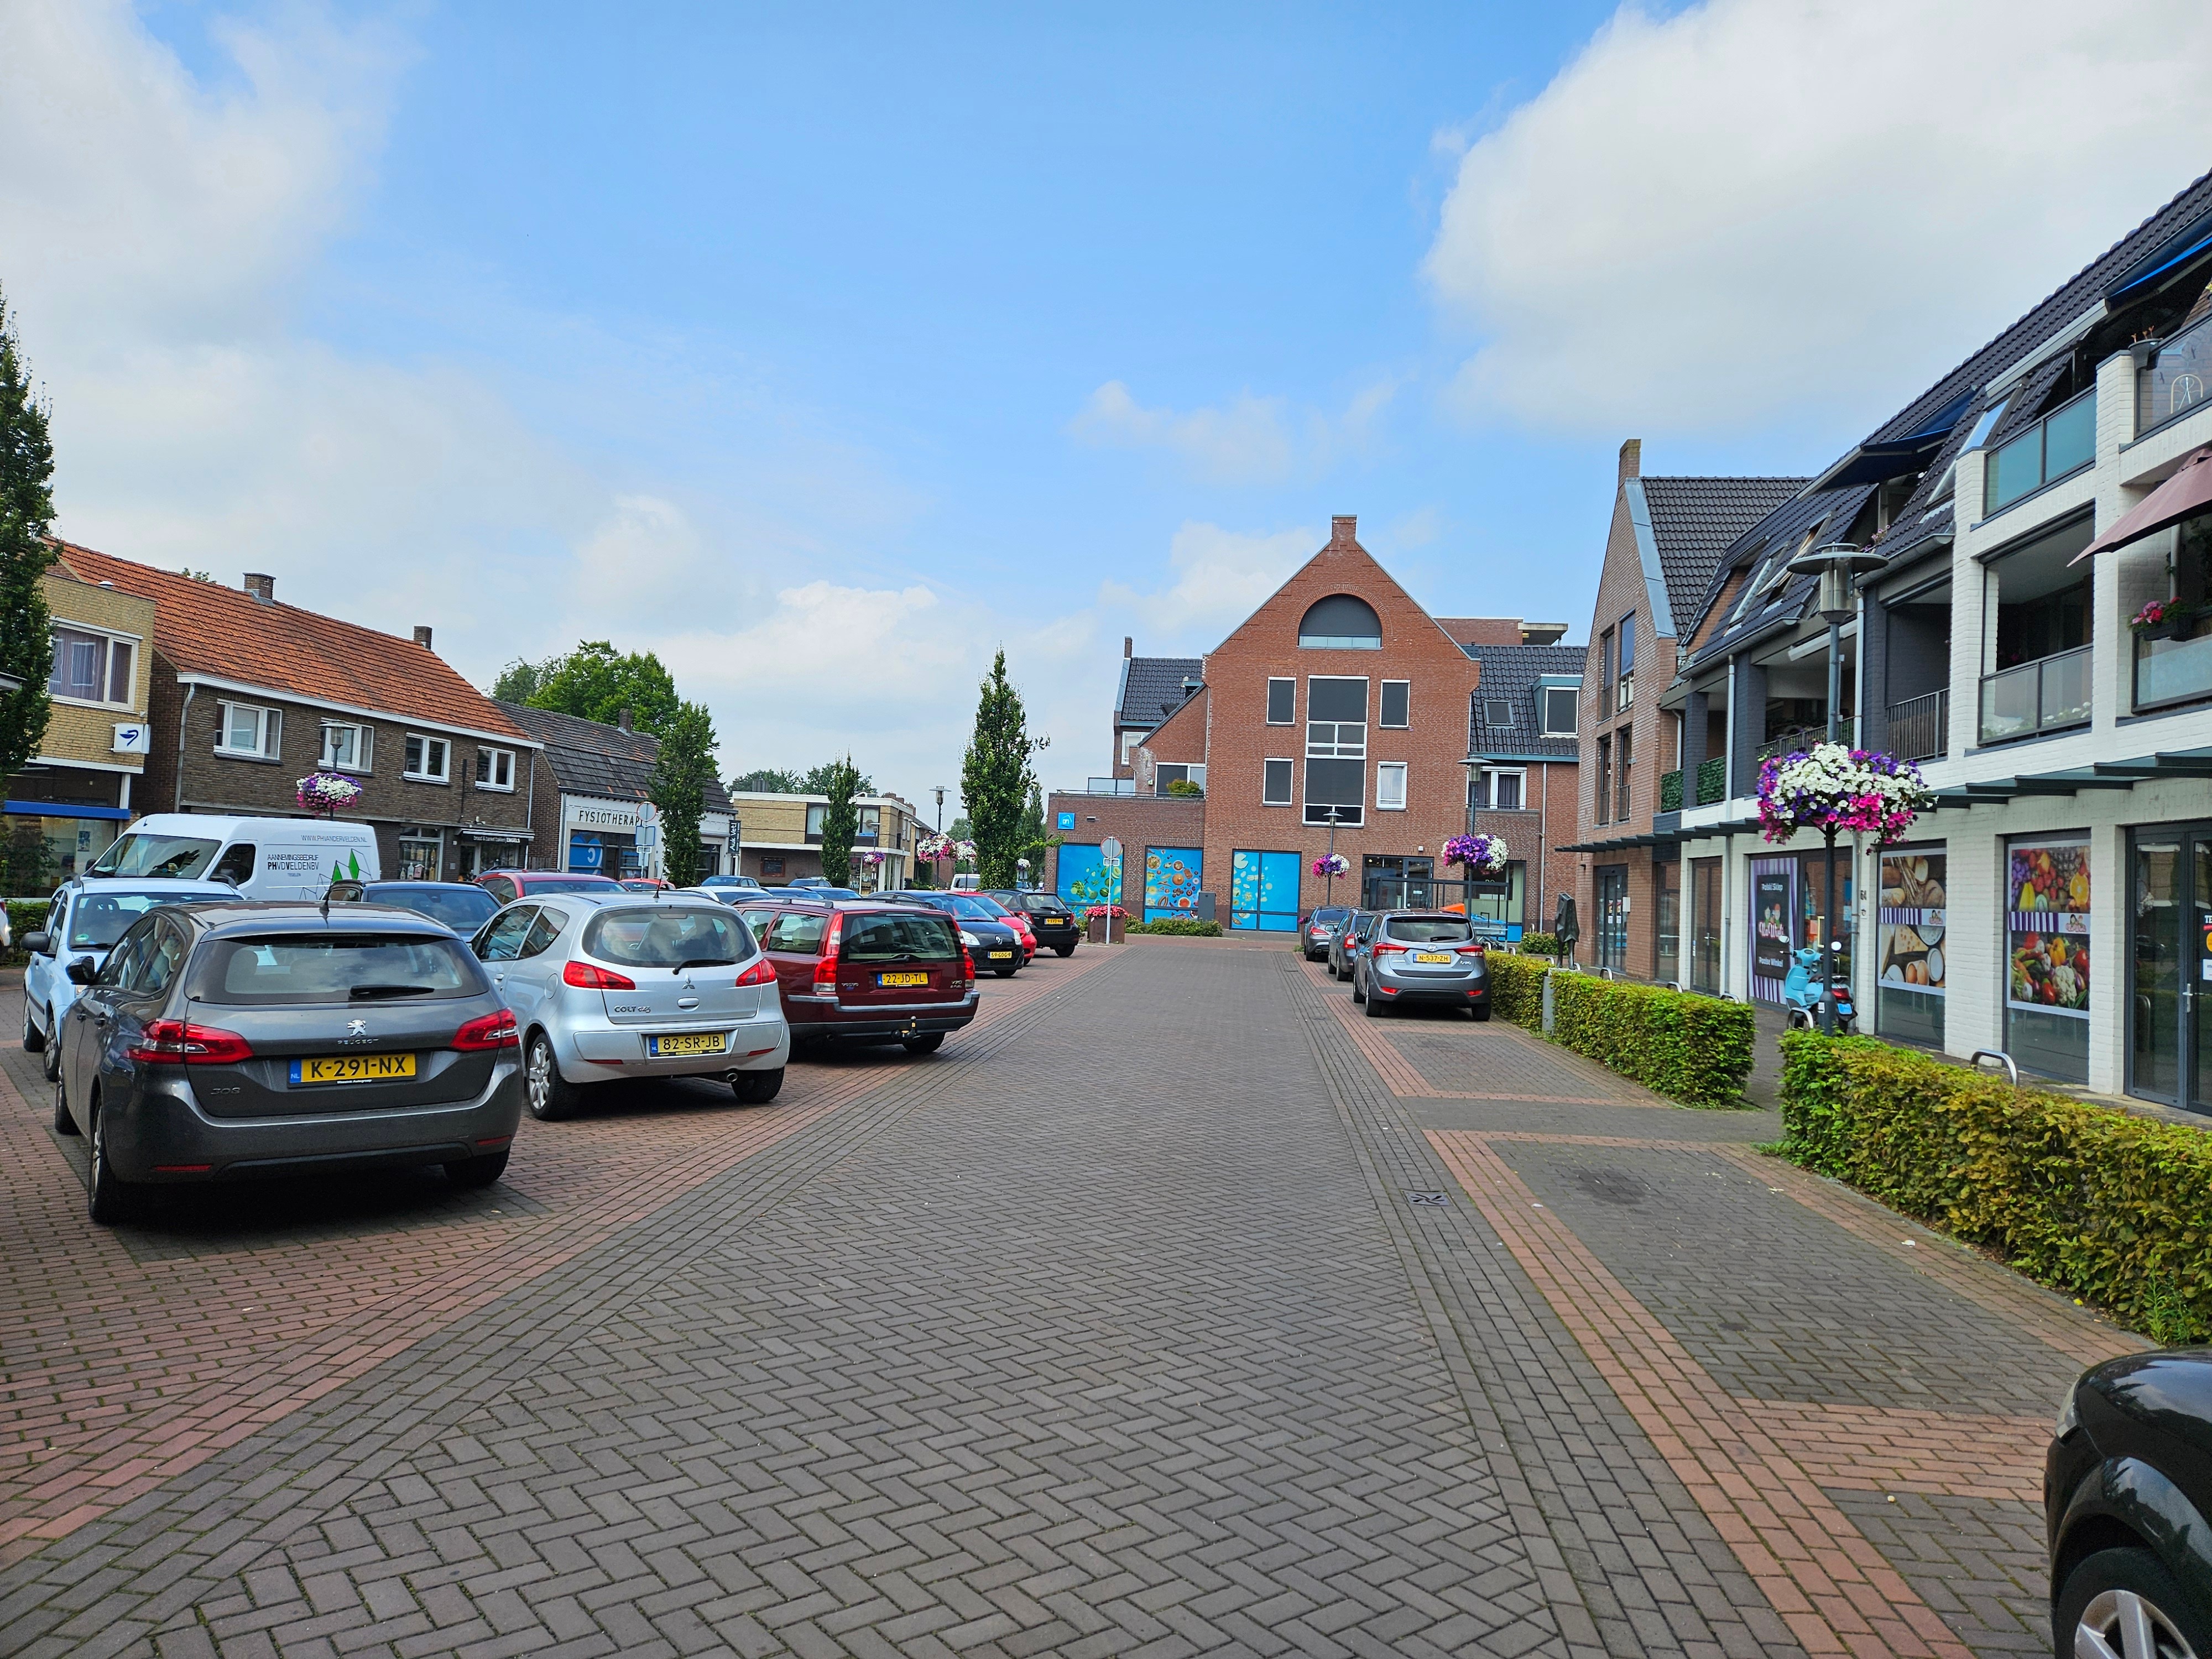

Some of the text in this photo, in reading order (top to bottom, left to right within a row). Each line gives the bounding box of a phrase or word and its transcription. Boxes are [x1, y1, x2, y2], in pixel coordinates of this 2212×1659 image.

[579, 810, 648, 826] FYSIOTHERAPI
[886, 974, 924, 983] 22-JD-TL
[664, 1036, 719, 1050] 82-SR-JB
[311, 1057, 406, 1078] K-291-NX
